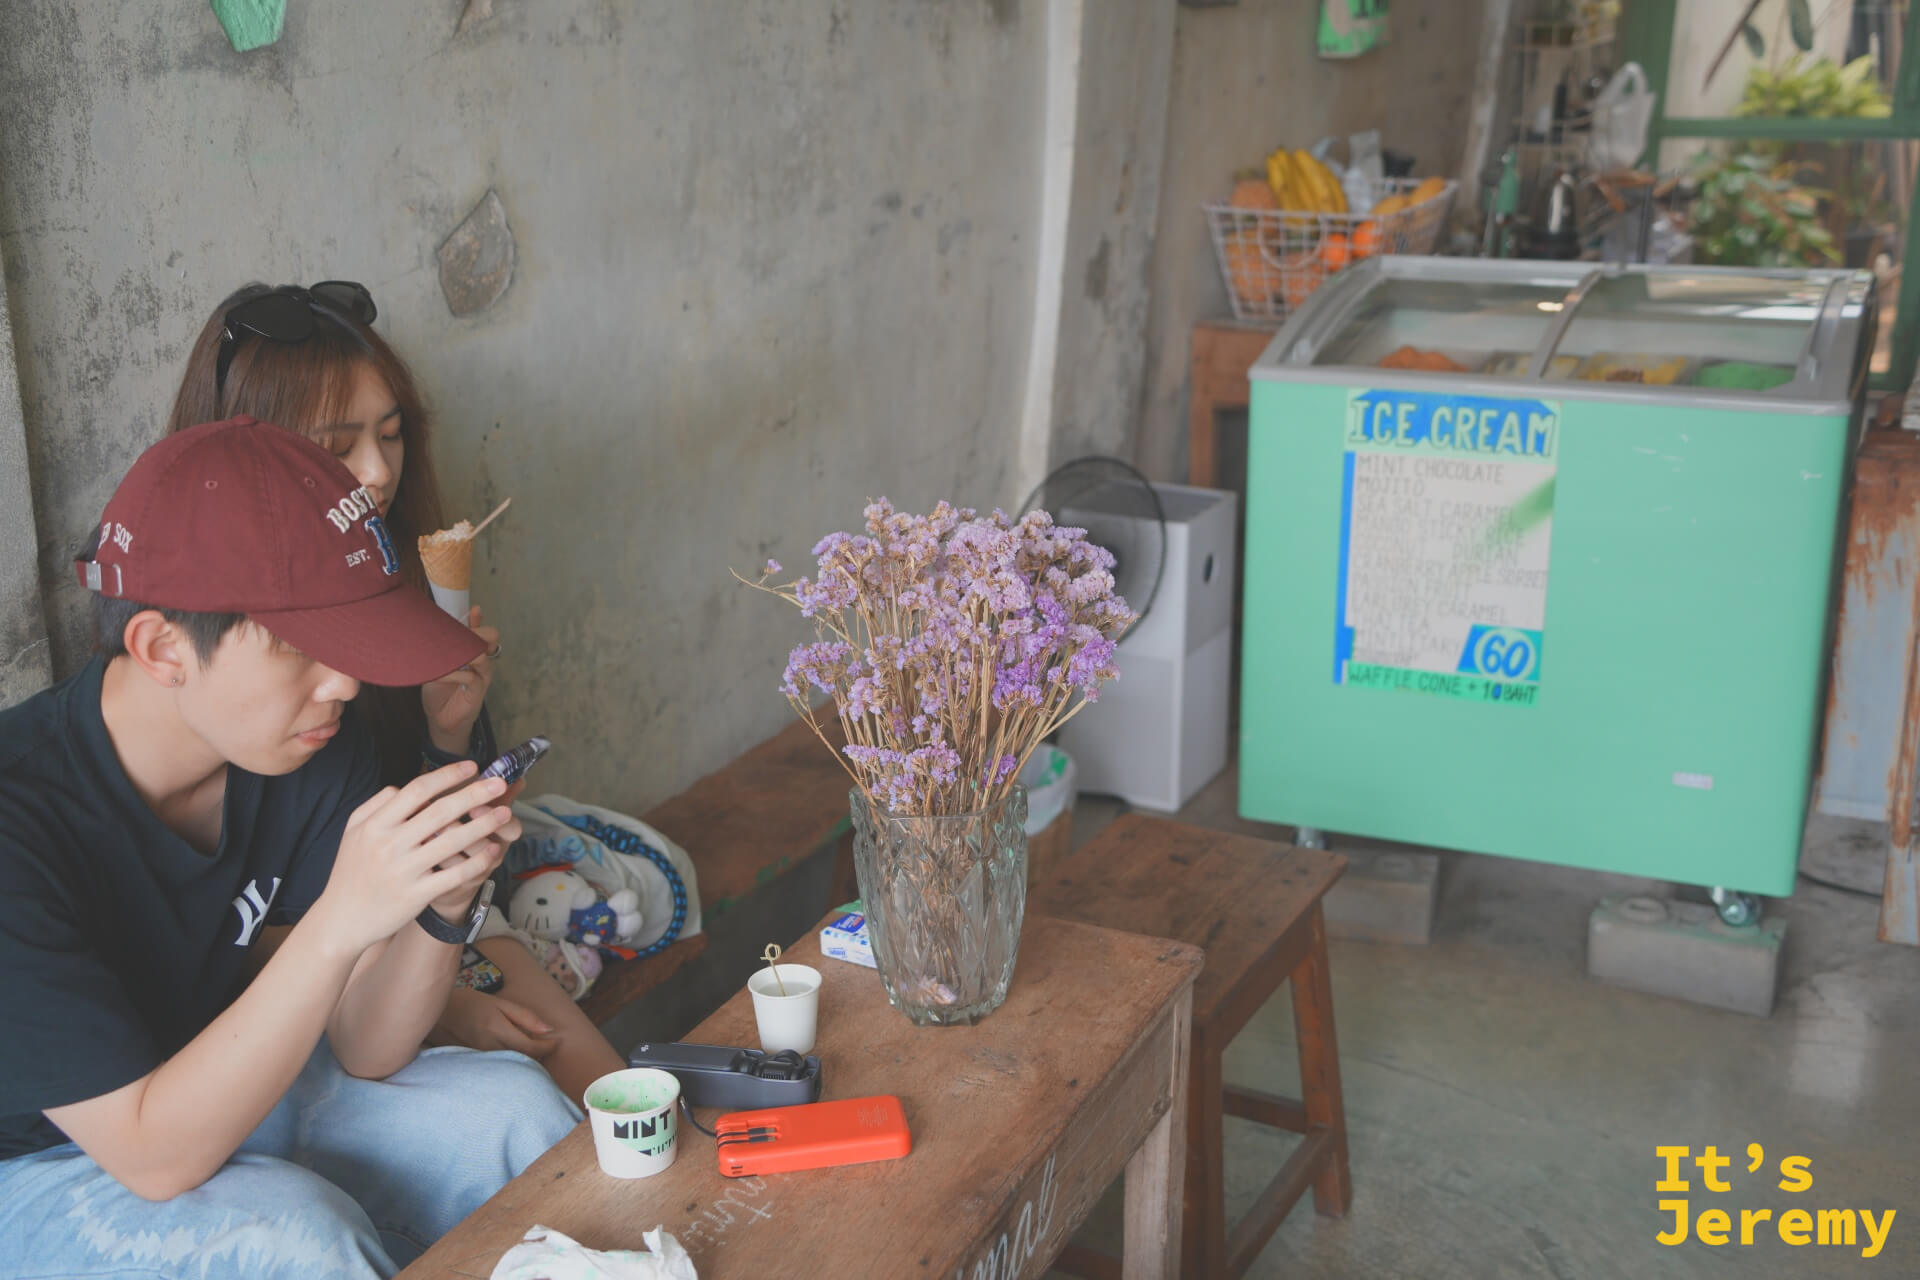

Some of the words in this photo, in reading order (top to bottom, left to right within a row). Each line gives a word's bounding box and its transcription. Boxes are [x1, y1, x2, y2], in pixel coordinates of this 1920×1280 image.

[1349, 400, 1417, 447] ICE
[1430, 405, 1557, 458] CREAM
[1358, 456, 1406, 475] MINT
[1414, 457, 1505, 486] CHOCOLATE
[1358, 476, 1425, 498] MOJITO
[1393, 496, 1433, 518] SALT
[1440, 501, 1514, 526] CARAMEL
[113, 522, 133, 554] SOX
[345, 549, 371, 568] EST.
[1482, 633, 1530, 678] 60
[1350, 666, 1413, 690] WAFFLE
[1418, 672, 1462, 695] CONE
[613, 1108, 671, 1139] MINT
